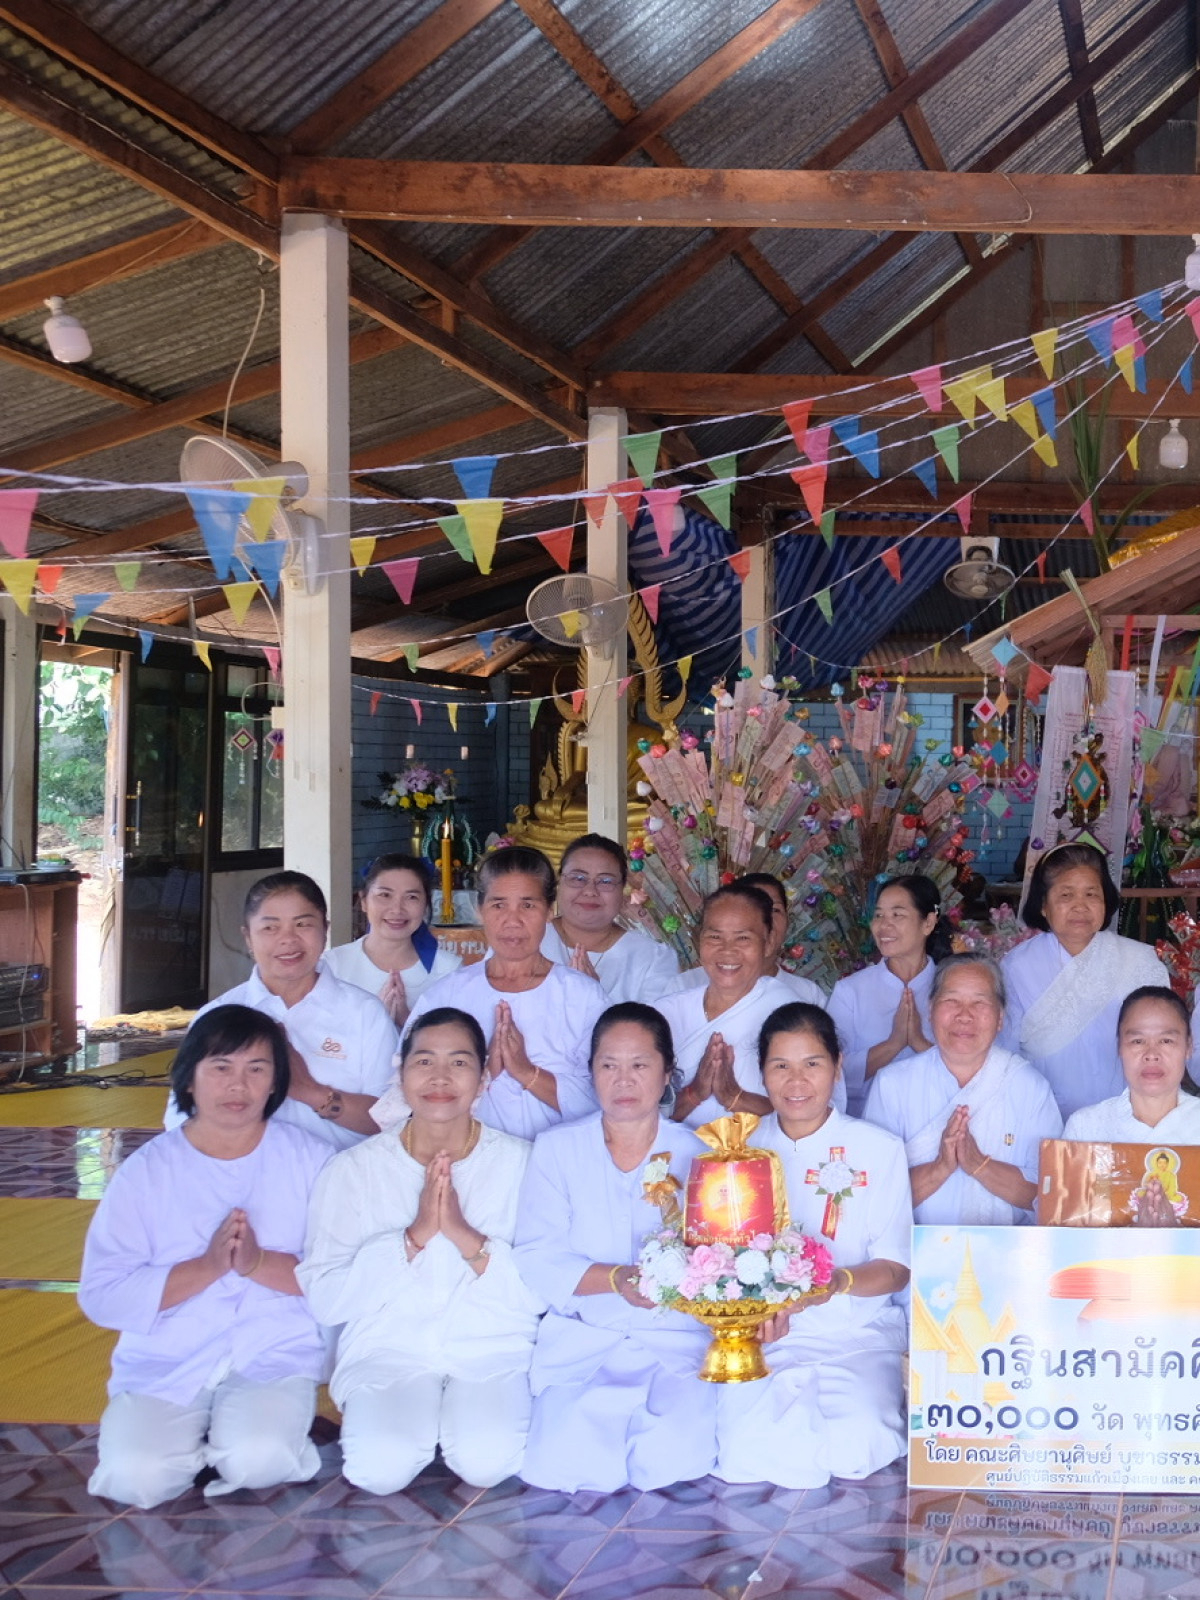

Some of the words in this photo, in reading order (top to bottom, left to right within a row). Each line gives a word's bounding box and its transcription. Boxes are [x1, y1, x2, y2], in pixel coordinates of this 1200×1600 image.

[927, 1403, 1080, 1434] ๓๐,๐๐๐
[1091, 1402, 1125, 1431] วัด
[925, 1440, 960, 1463] โดย
[965, 1443, 1112, 1470] คณะศิษยานุศิษย์
[1161, 1475, 1185, 1486] และ
